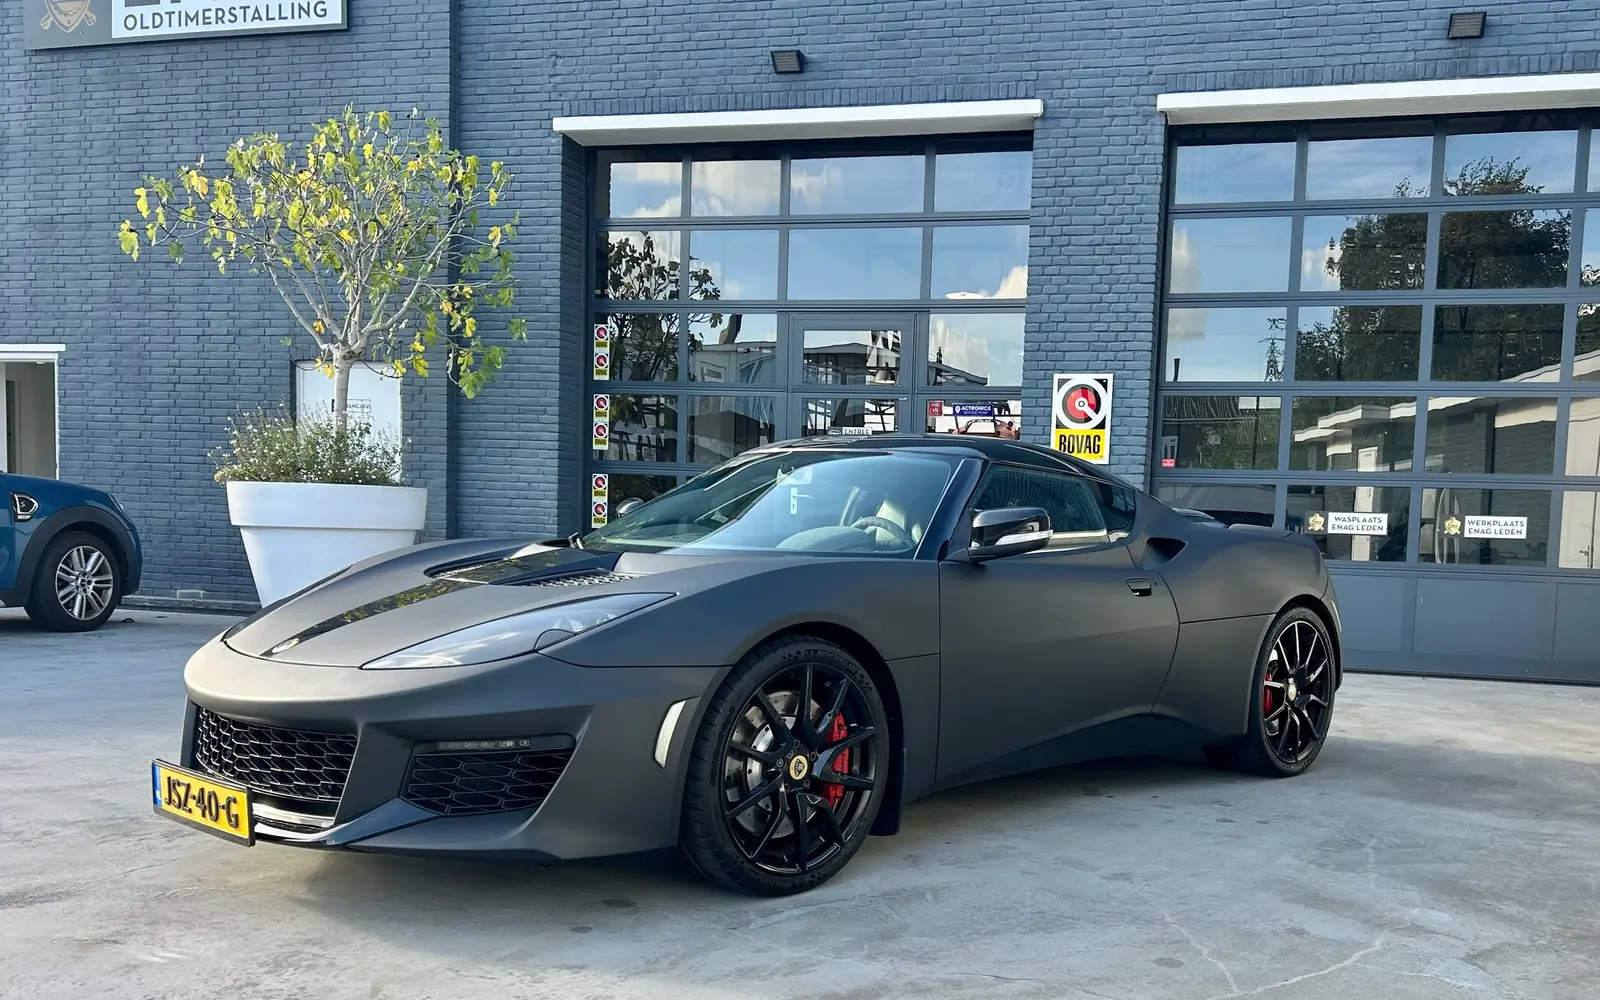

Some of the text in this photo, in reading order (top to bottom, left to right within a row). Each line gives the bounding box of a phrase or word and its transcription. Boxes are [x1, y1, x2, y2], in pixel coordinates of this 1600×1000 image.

[123, 1, 328, 31] OLDTIMERSTALLING
[1059, 434, 1101, 454] BOVAG
[1334, 516, 1383, 524] WASPLAATS
[1467, 519, 1525, 527] WERKPLAATS
[1356, 524, 1384, 532] LEDEN
[1468, 527, 1492, 535] ENAG
[164, 776, 239, 829] JSZ-40-G
